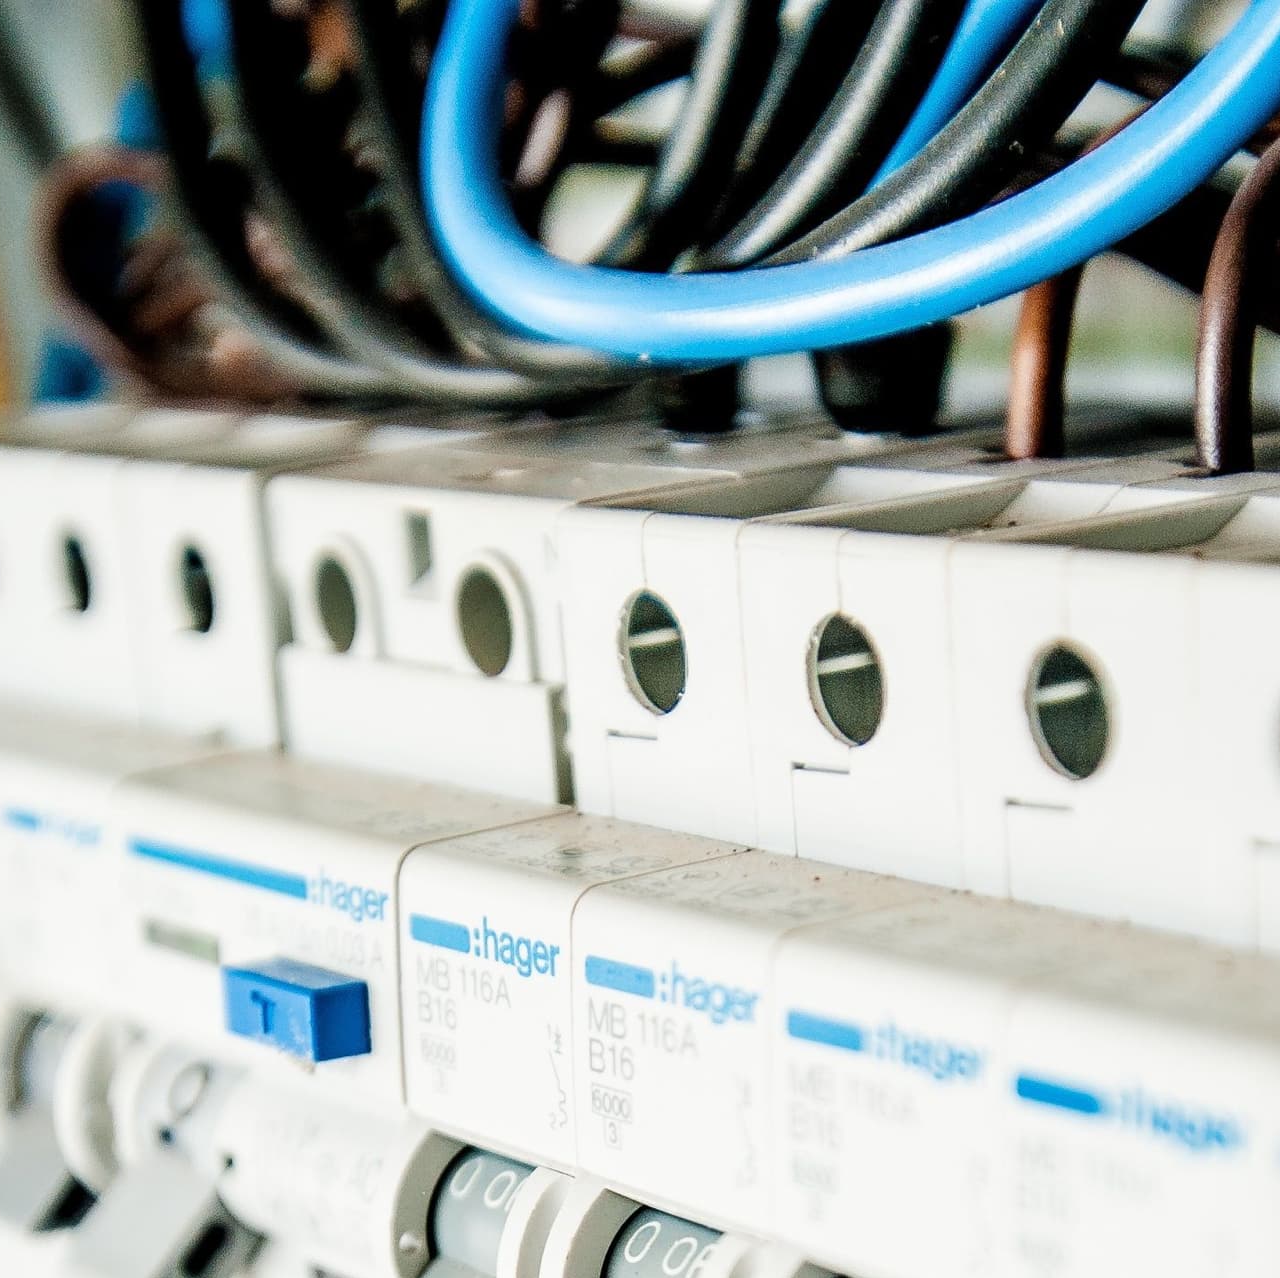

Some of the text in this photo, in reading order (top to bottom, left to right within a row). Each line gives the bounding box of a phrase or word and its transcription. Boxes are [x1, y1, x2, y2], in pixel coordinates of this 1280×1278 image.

[416, 953, 513, 1009] MB 116A
[417, 988, 458, 1032] B16
[587, 996, 701, 1062] MB 116A
[587, 1036, 636, 1082] B16
